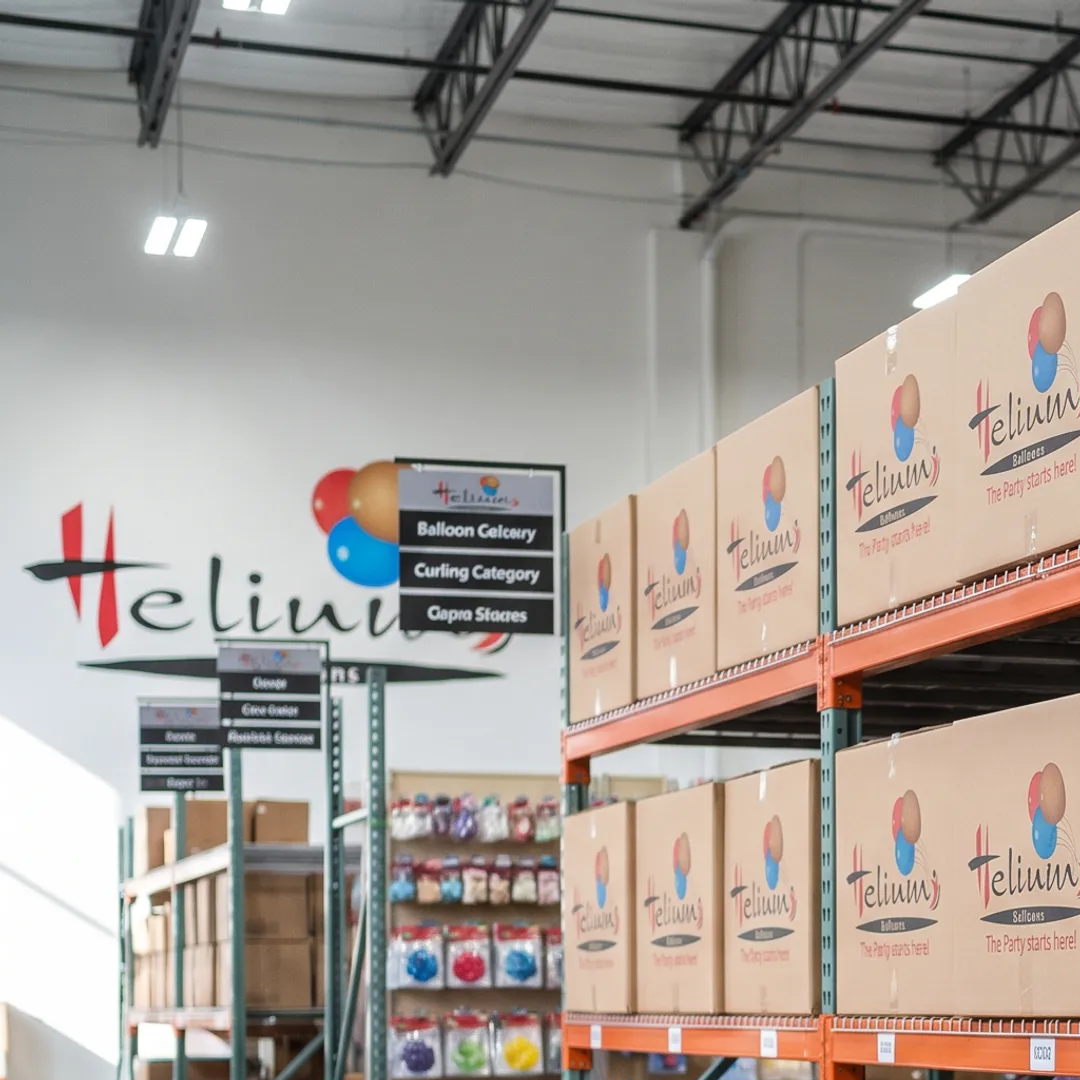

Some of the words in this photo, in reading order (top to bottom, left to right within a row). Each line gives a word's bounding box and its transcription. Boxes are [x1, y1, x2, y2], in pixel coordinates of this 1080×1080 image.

[968, 377, 1080, 464] Helium
[846, 446, 931, 522] Helium
[986, 487, 1002, 505] The
[1003, 478, 1024, 499] Party
[1027, 468, 1051, 490] starts
[1054, 453, 1077, 479] here!
[417, 521, 474, 538] Balloon
[23, 501, 400, 650] Heliu
[414, 562, 469, 583] Curling
[472, 564, 540, 585] Category
[846, 841, 932, 919] Helium
[968, 822, 1079, 909] Helium
[986, 934, 1001, 952] The
[1003, 934, 1025, 957] Party
[1027, 933, 1051, 952] starts
[1053, 929, 1077, 950] here!
